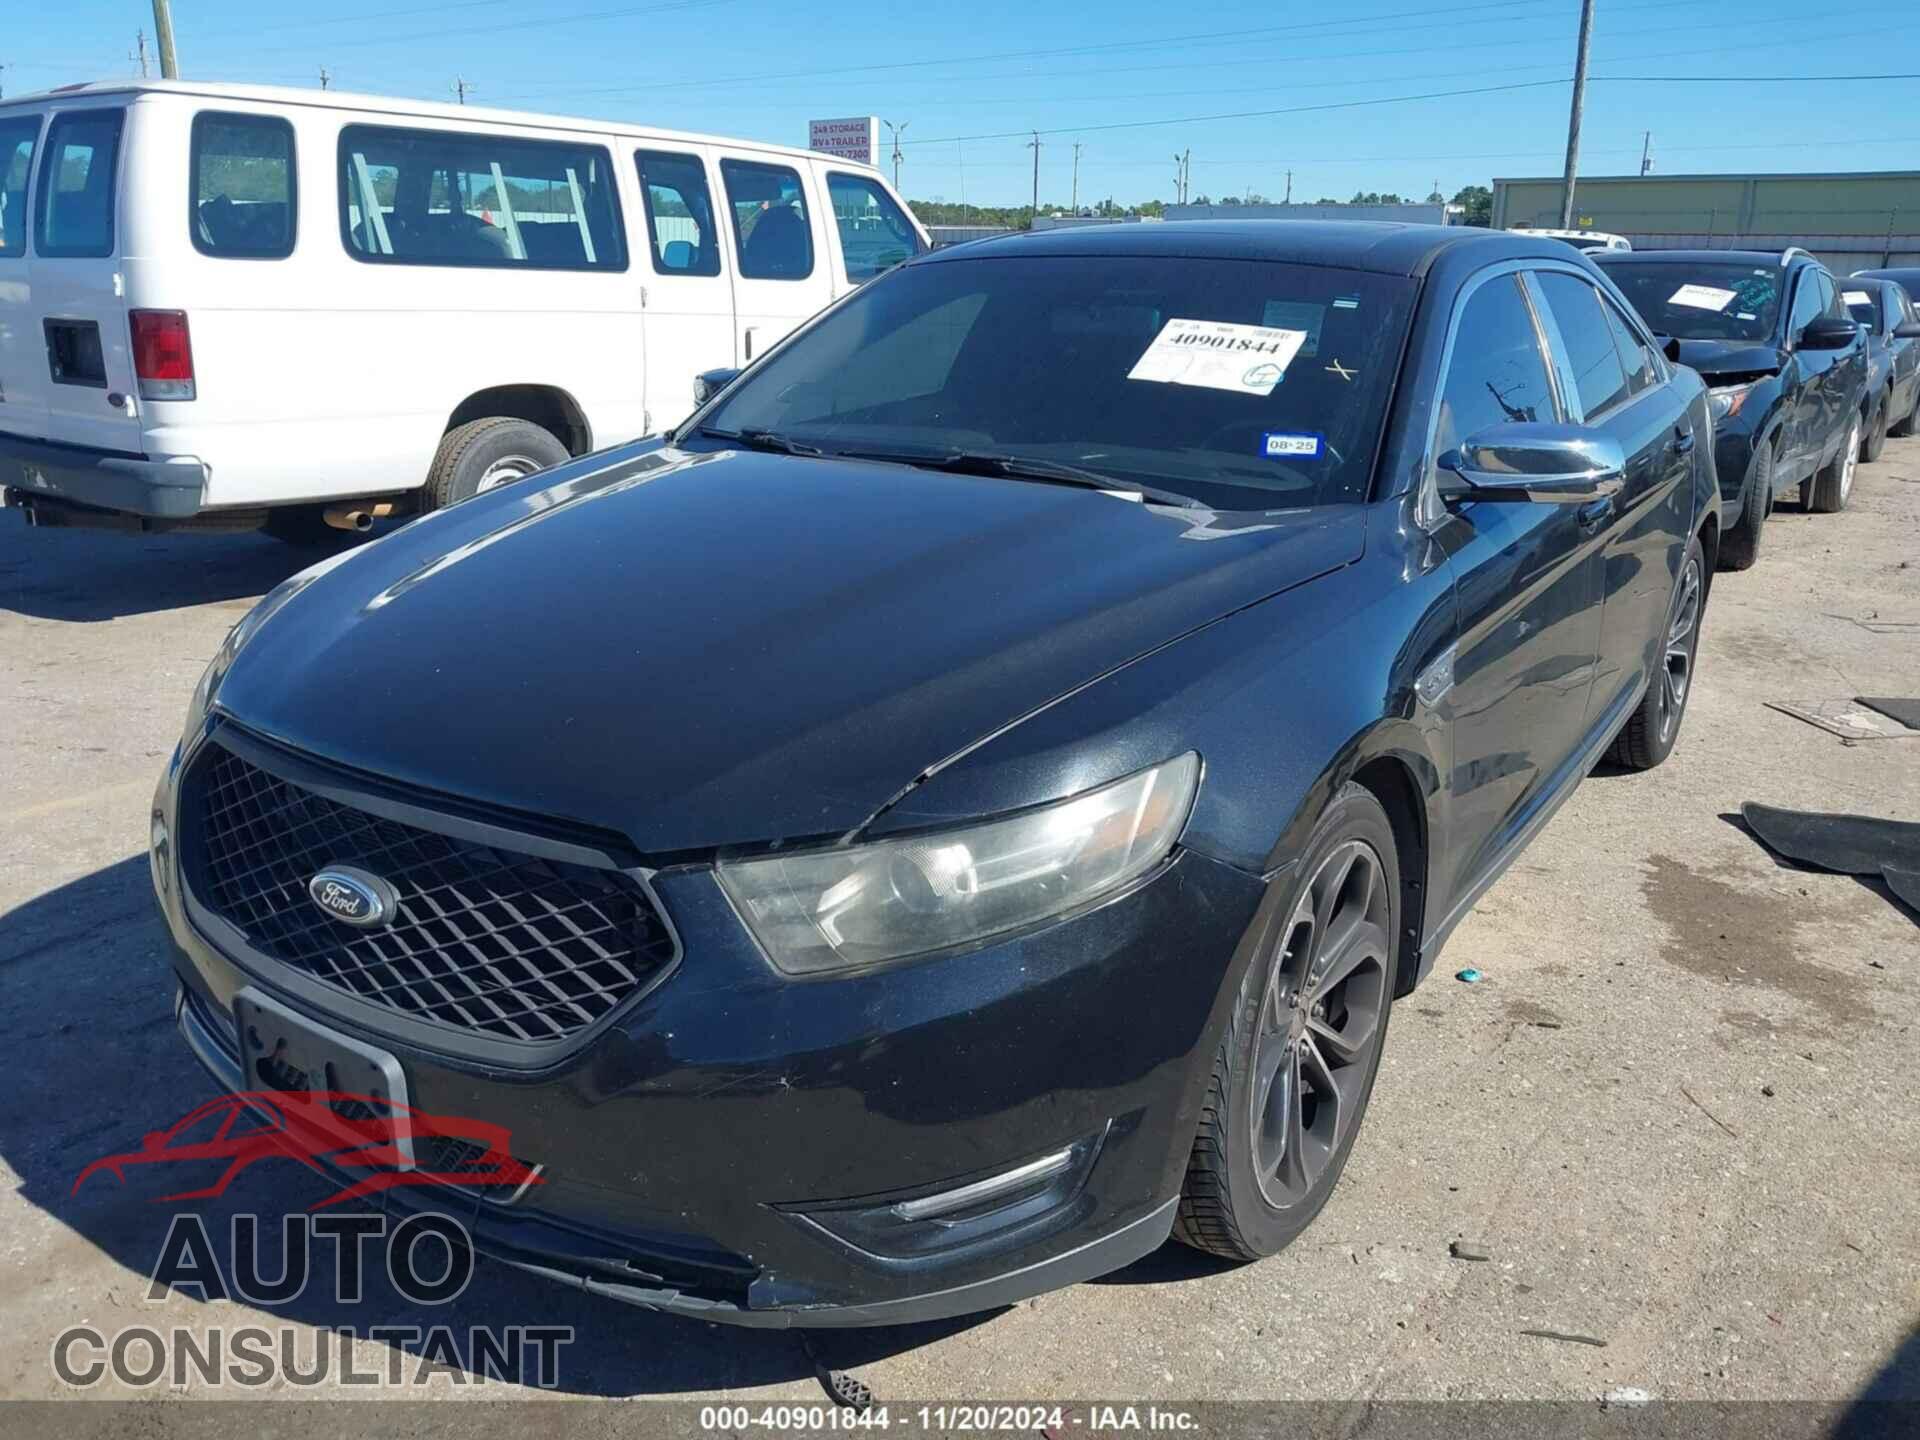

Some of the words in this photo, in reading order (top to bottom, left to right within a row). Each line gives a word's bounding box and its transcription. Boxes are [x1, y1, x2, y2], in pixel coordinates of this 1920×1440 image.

[829, 123, 865, 133] STORAGE
[831, 136, 867, 146] TRAILER
[1170, 332, 1281, 354] 40901844
[1270, 440, 1314, 450] 08-25
[321, 882, 360, 914] Ford
